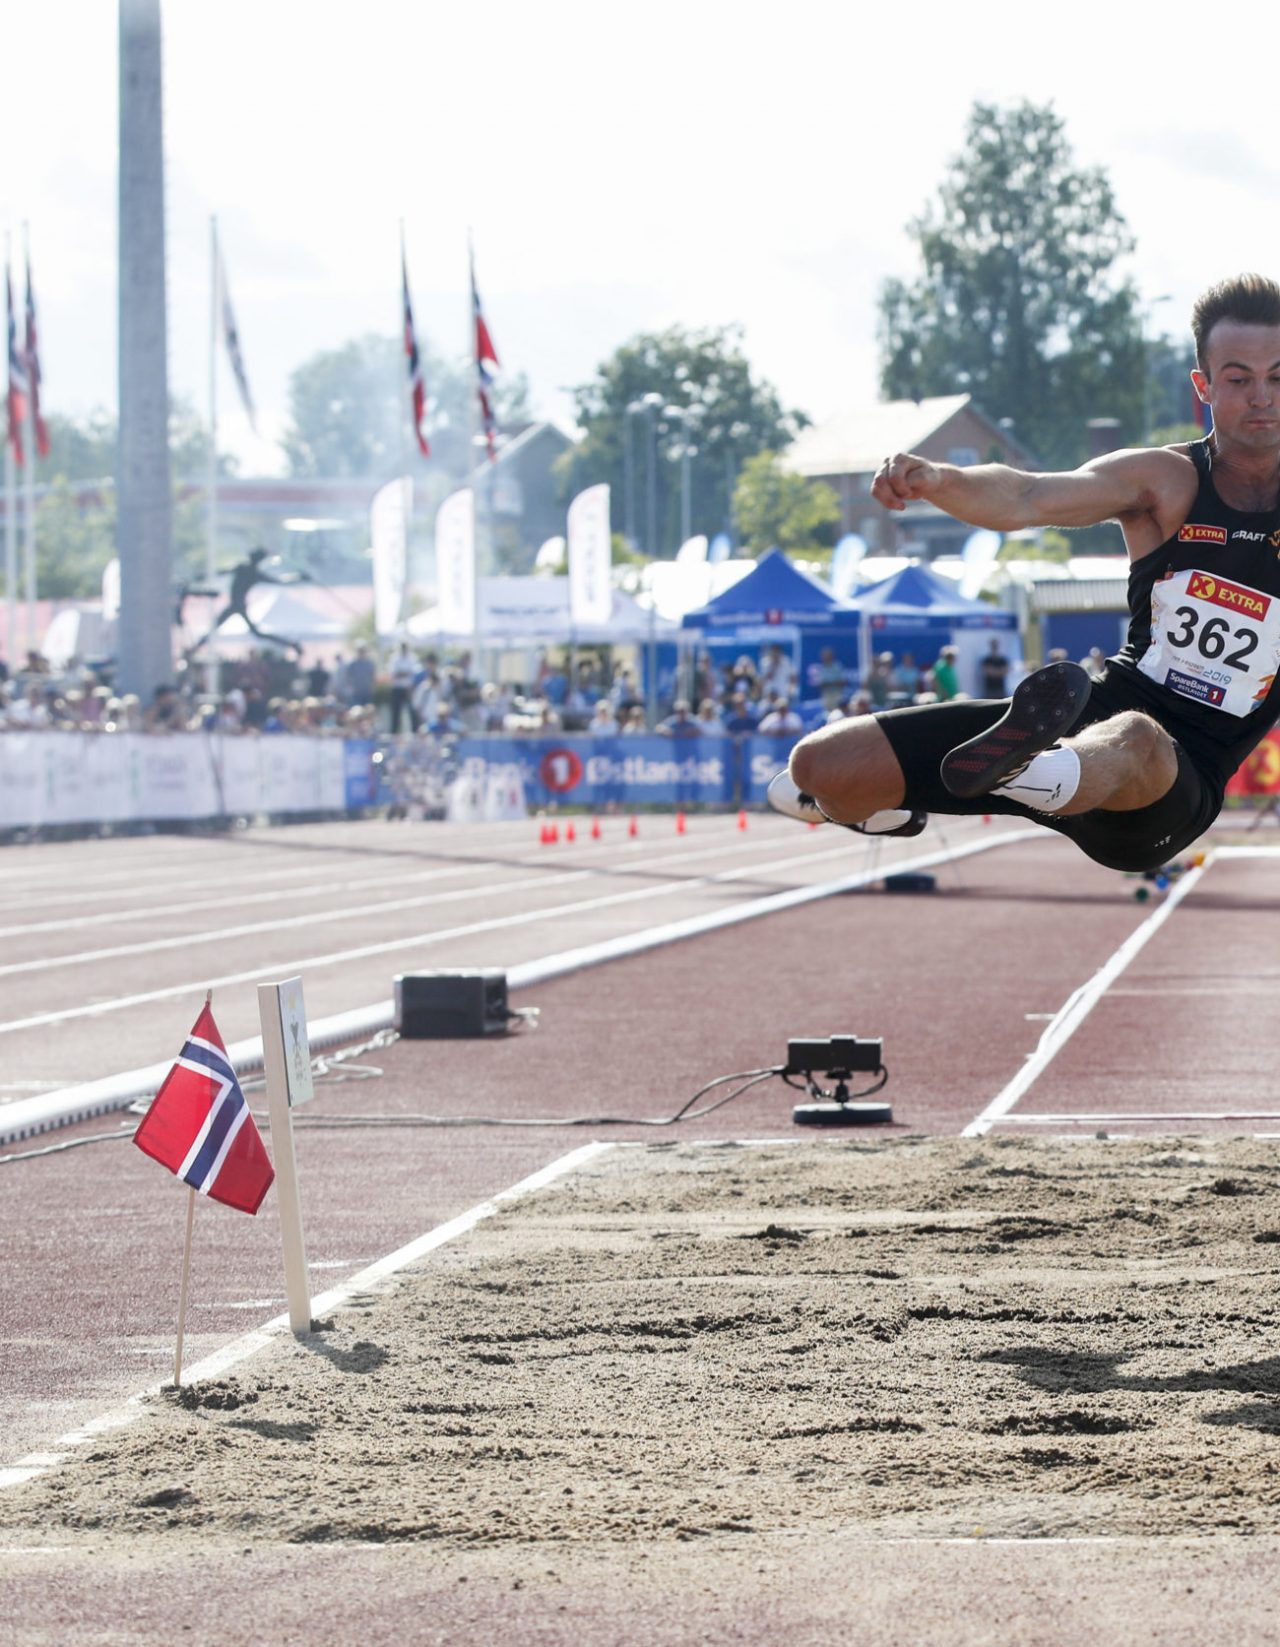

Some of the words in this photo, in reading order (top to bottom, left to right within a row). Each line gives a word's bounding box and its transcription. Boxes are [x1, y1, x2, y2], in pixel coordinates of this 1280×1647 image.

[1195, 528, 1224, 539] EXTRA
[1218, 588, 1264, 615] EXTRA
[1167, 606, 1259, 673] 362
[1169, 672, 1209, 693] SpareBank
[1202, 669, 1232, 685] 2019
